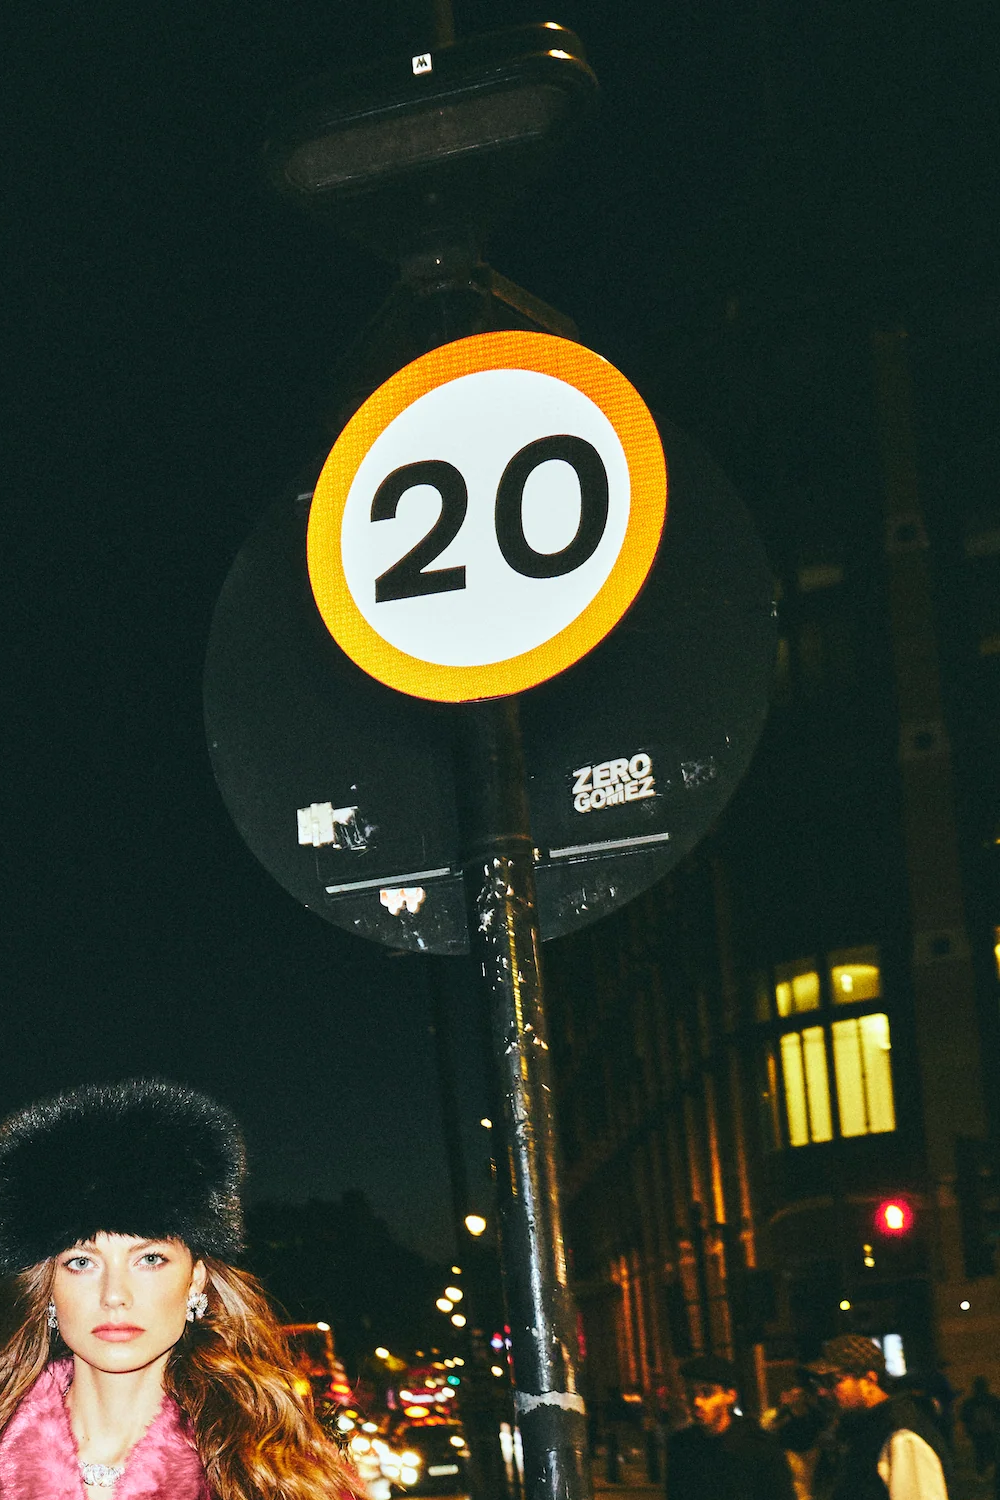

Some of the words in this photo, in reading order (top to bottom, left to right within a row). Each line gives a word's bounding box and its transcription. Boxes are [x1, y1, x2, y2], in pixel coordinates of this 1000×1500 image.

[370, 434, 609, 604] 20
[572, 753, 652, 794] ZERO
[573, 775, 656, 813] GOMEZ
